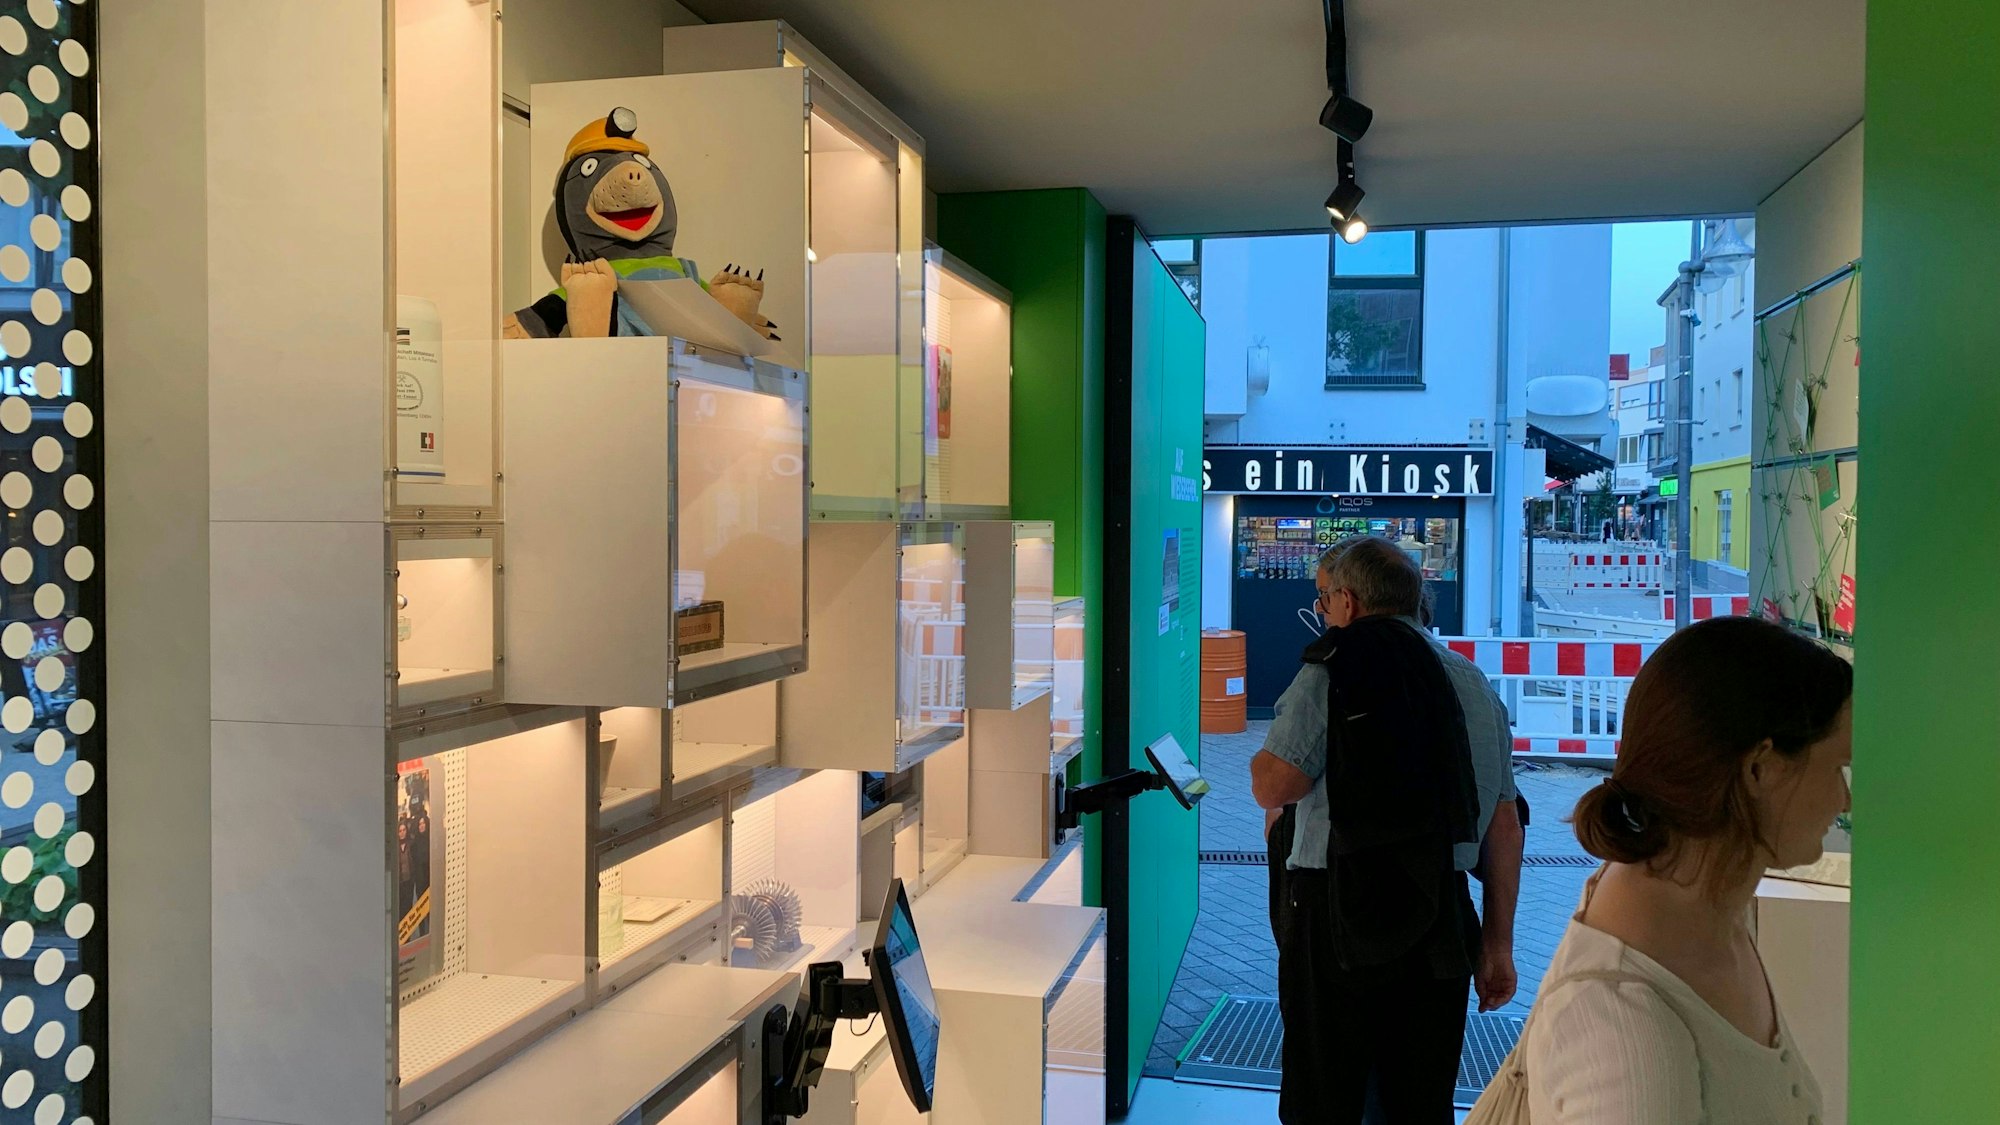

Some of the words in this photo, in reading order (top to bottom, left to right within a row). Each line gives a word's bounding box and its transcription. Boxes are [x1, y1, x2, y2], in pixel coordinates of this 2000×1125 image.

[0, 366, 72, 396] LSI
[1245, 450, 1313, 491] ein
[1349, 454, 1480, 494] Kiosk
[1339, 497, 1374, 507] IQOS
